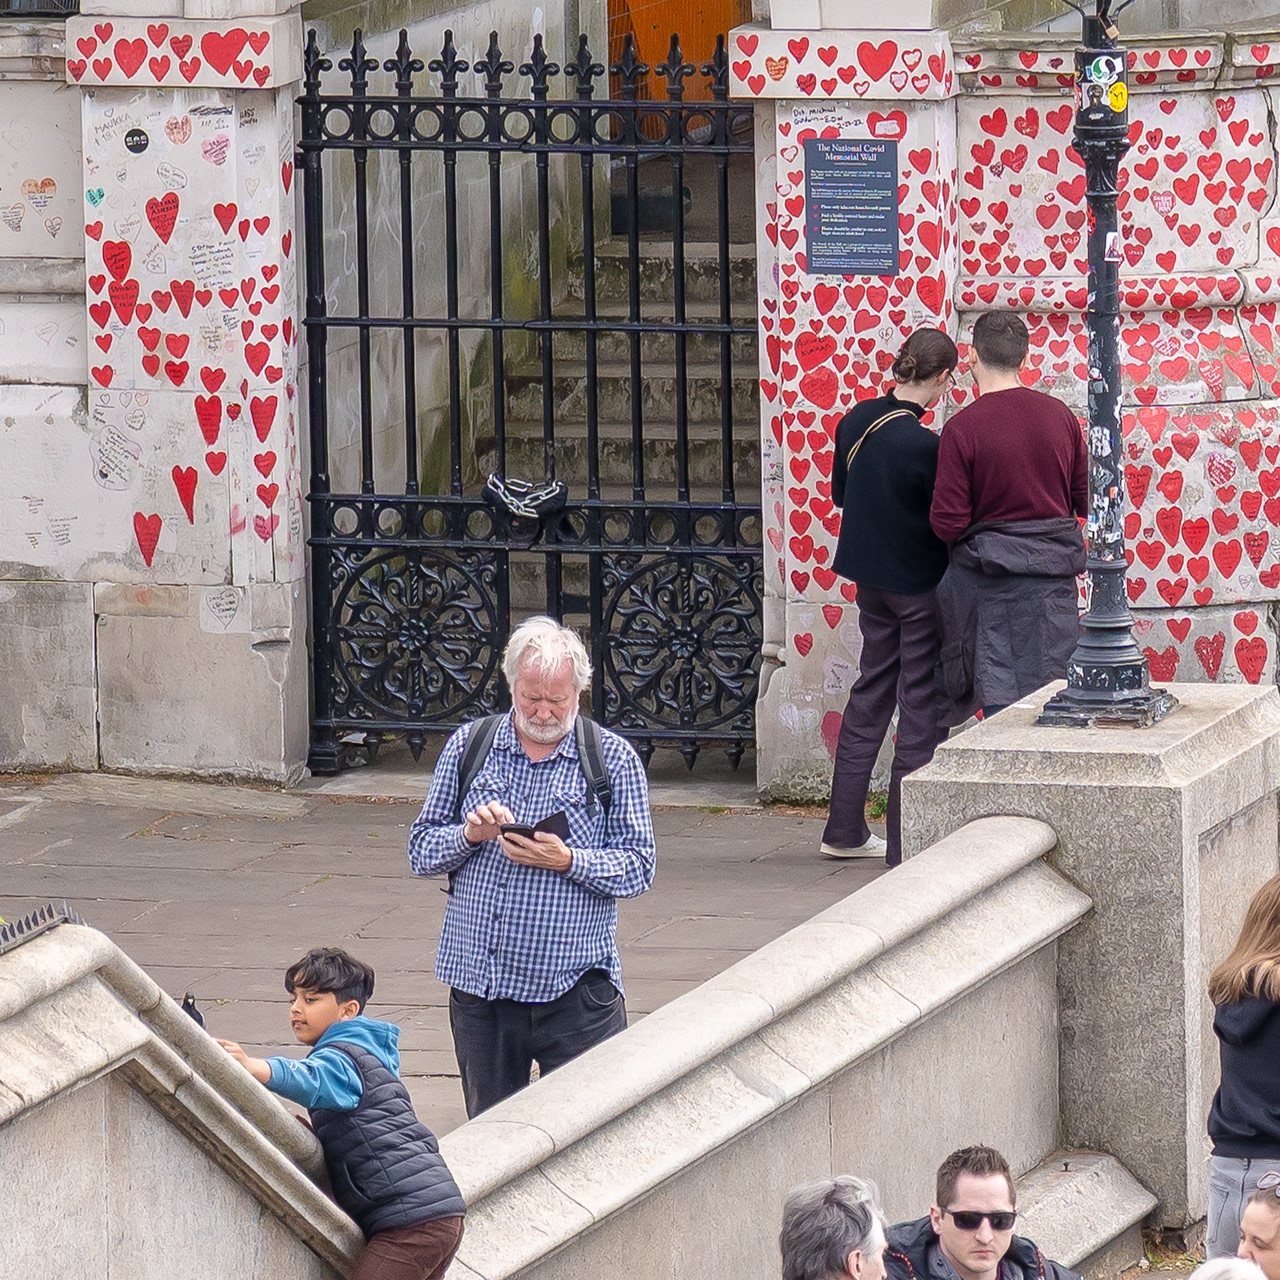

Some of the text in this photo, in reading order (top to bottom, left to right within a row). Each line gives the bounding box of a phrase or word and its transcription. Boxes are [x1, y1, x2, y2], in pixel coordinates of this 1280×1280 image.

[817, 143, 885, 152] The National Covid
[825, 152, 877, 161] Memorial Wall
